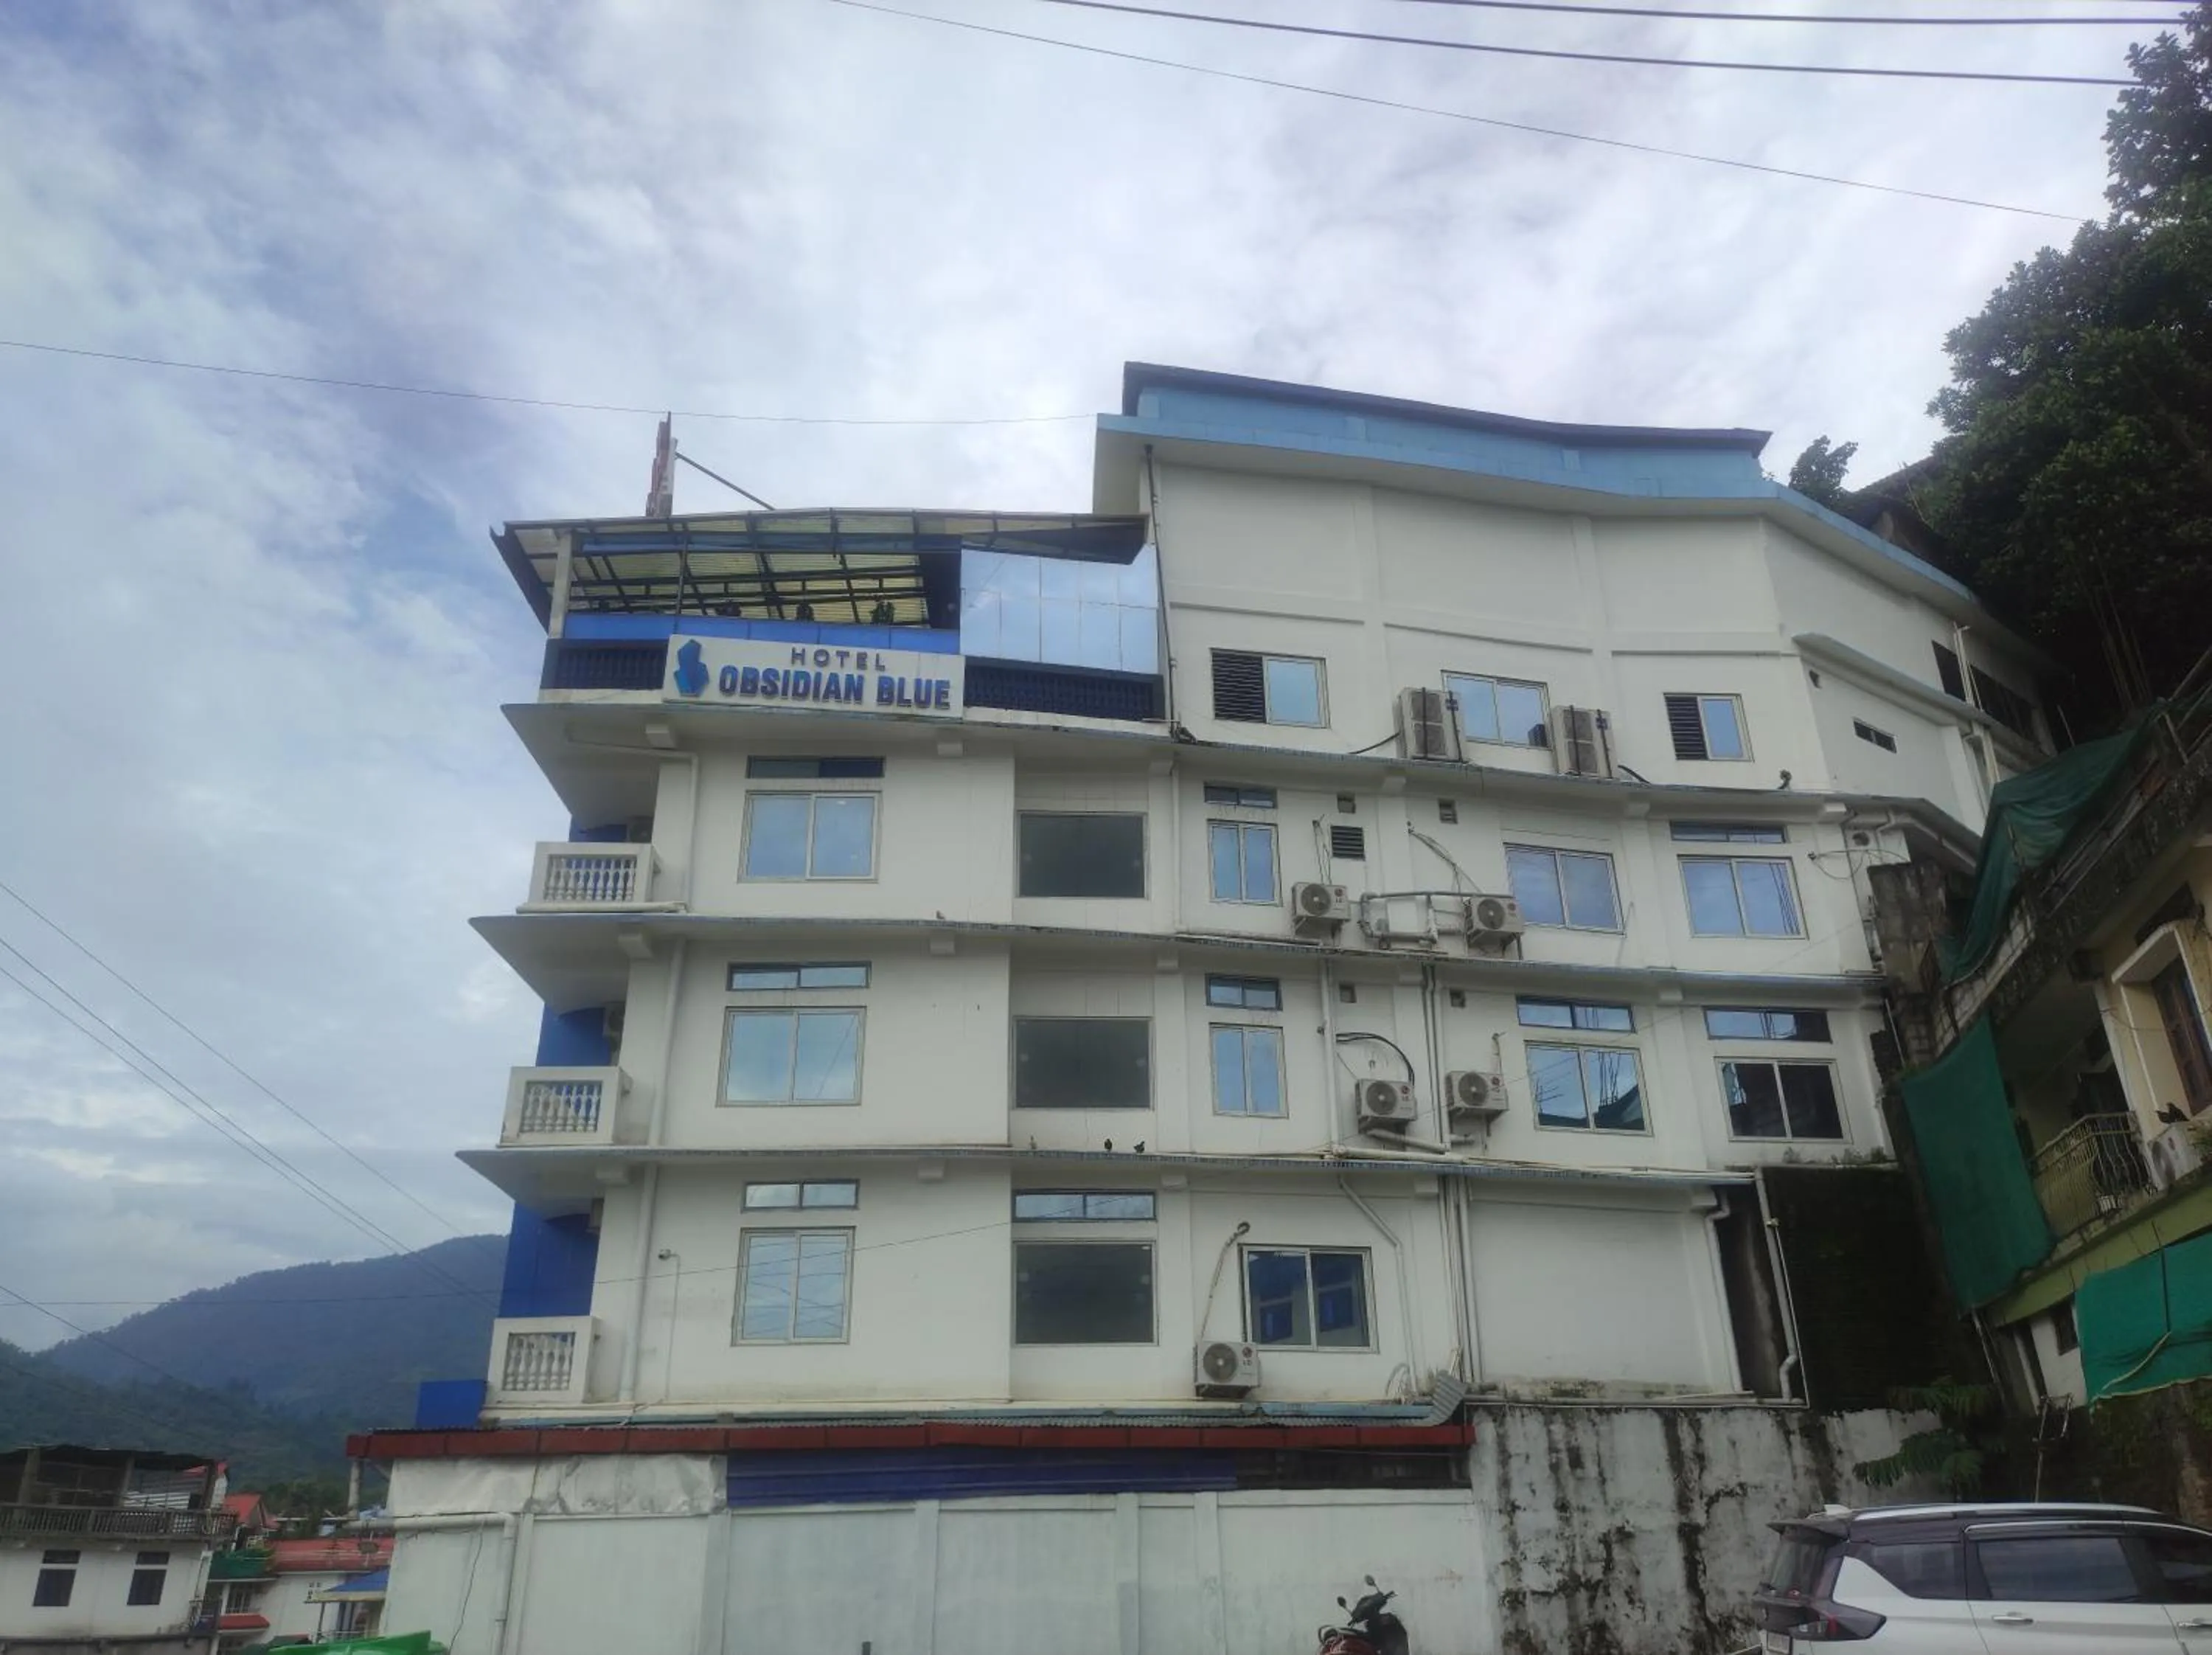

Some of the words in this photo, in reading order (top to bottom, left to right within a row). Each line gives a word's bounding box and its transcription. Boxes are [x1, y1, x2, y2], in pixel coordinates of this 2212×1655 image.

[791, 646, 886, 671] HOTEL
[719, 665, 864, 705] OBSIDIAN
[877, 676, 950, 710] BLUE
